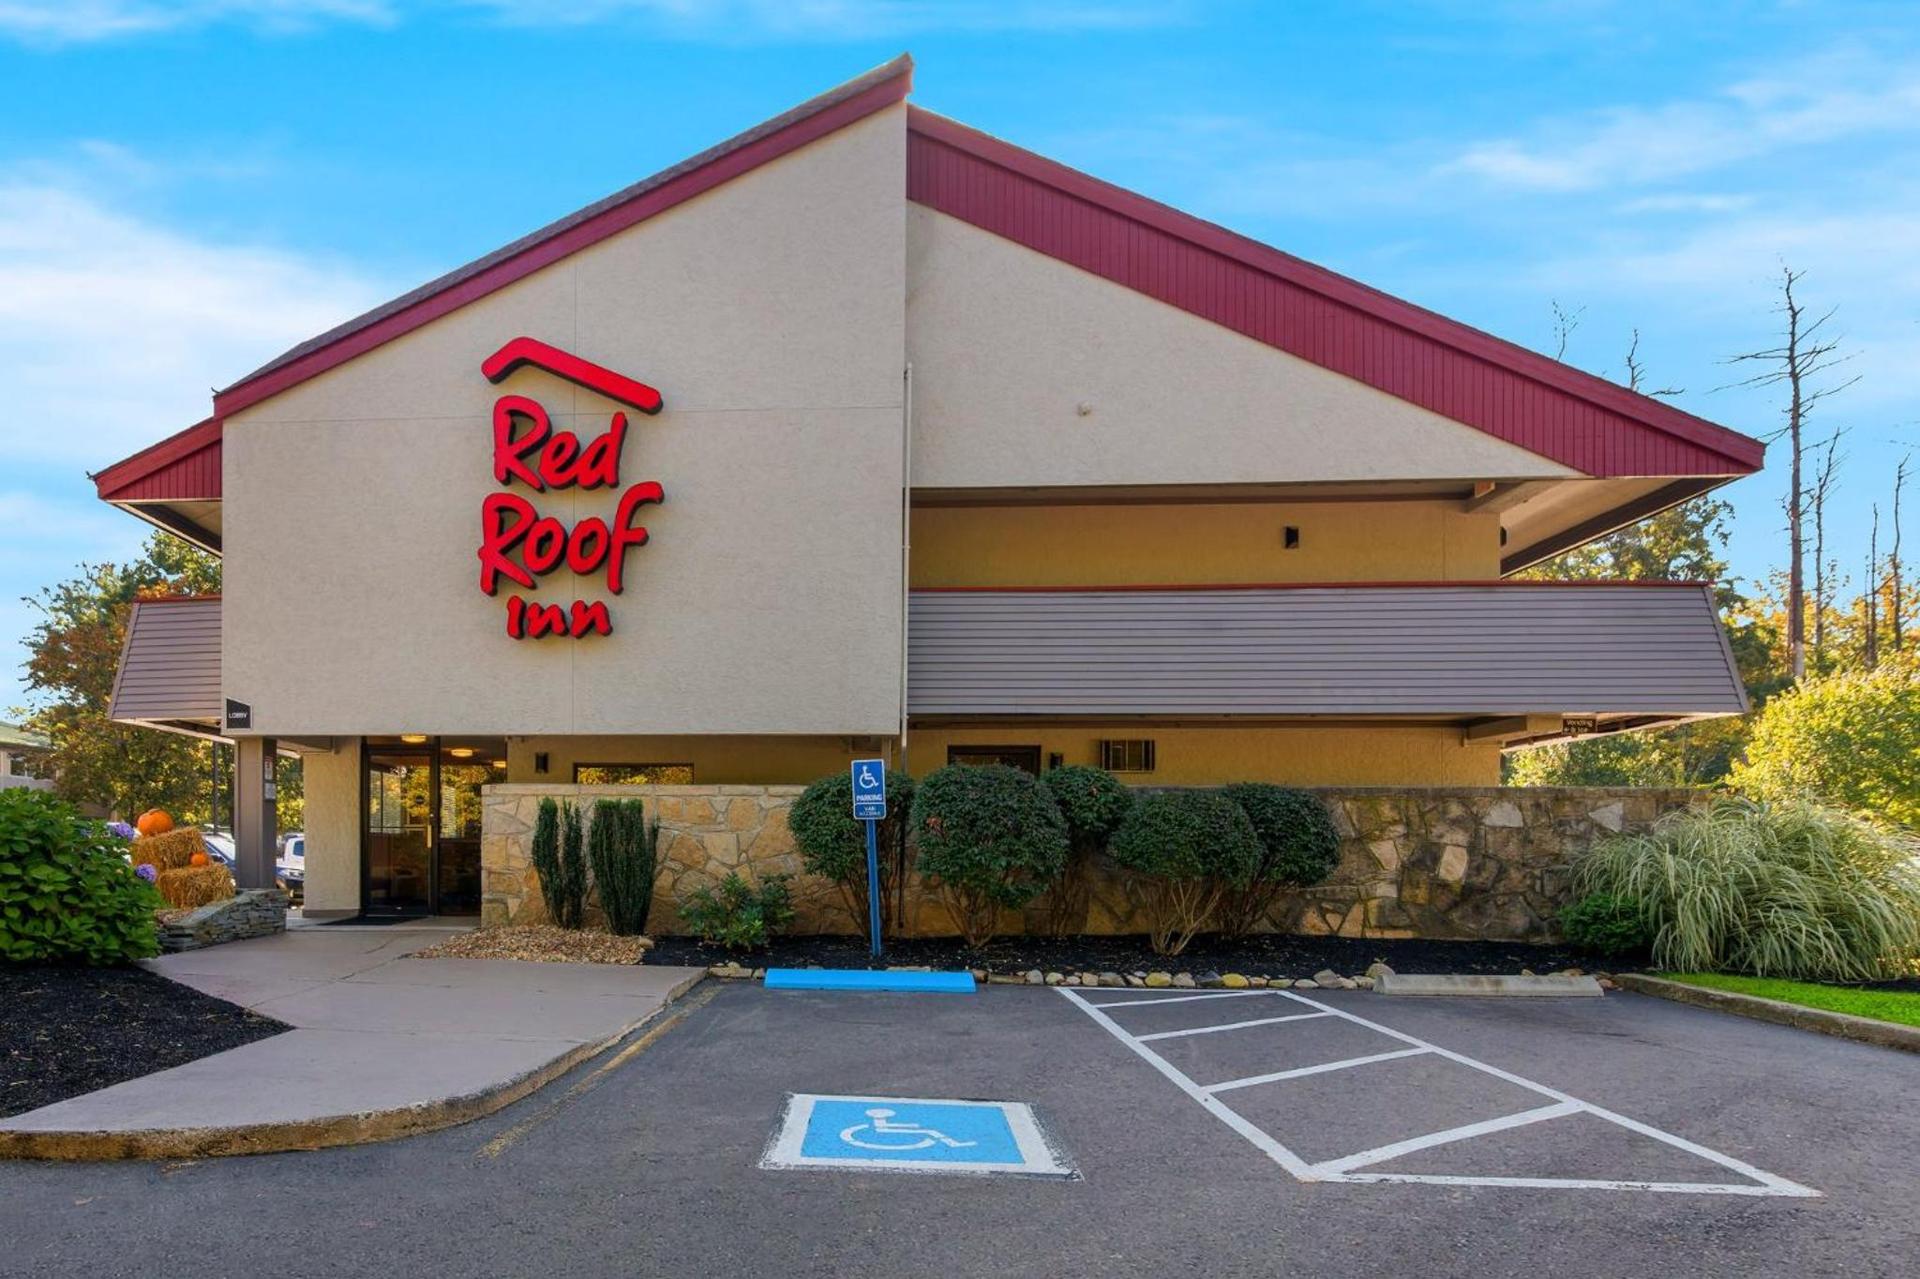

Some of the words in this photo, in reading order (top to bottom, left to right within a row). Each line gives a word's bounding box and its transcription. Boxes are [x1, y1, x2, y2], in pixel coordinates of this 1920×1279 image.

[493, 395, 628, 493] Red
[478, 481, 664, 596] Roof
[507, 595, 613, 640] Inn
